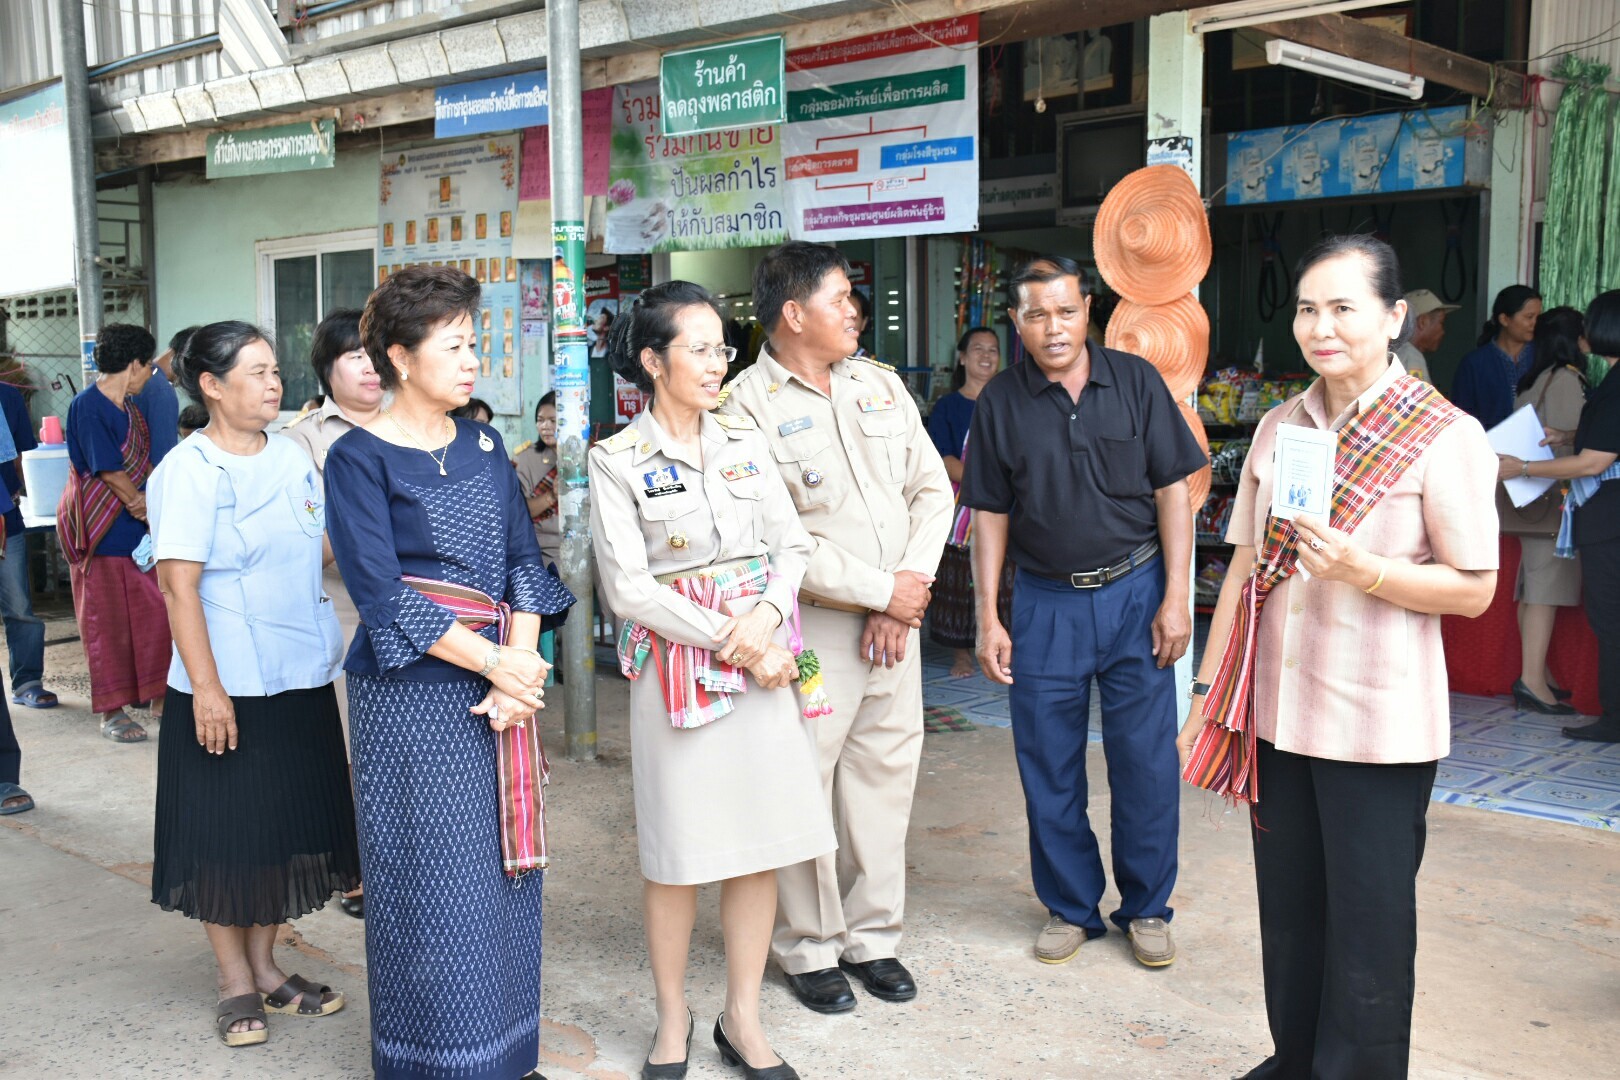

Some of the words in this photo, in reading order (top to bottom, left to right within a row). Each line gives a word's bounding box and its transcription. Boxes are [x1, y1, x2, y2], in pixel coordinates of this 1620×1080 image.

[694, 54, 746, 87] ร้านค้า
[434, 81, 549, 126] ที่ทำการกลุ่มออมทรัพย์เพื่อการผลิต
[667, 80, 776, 124] ลดถุงพลาสติก
[799, 79, 949, 119] กลุ่มออมทรัพย์เพื่อการผลิต
[671, 156, 777, 198] ปันผลกำไร
[667, 202, 782, 238] ให้กับสมาชิก
